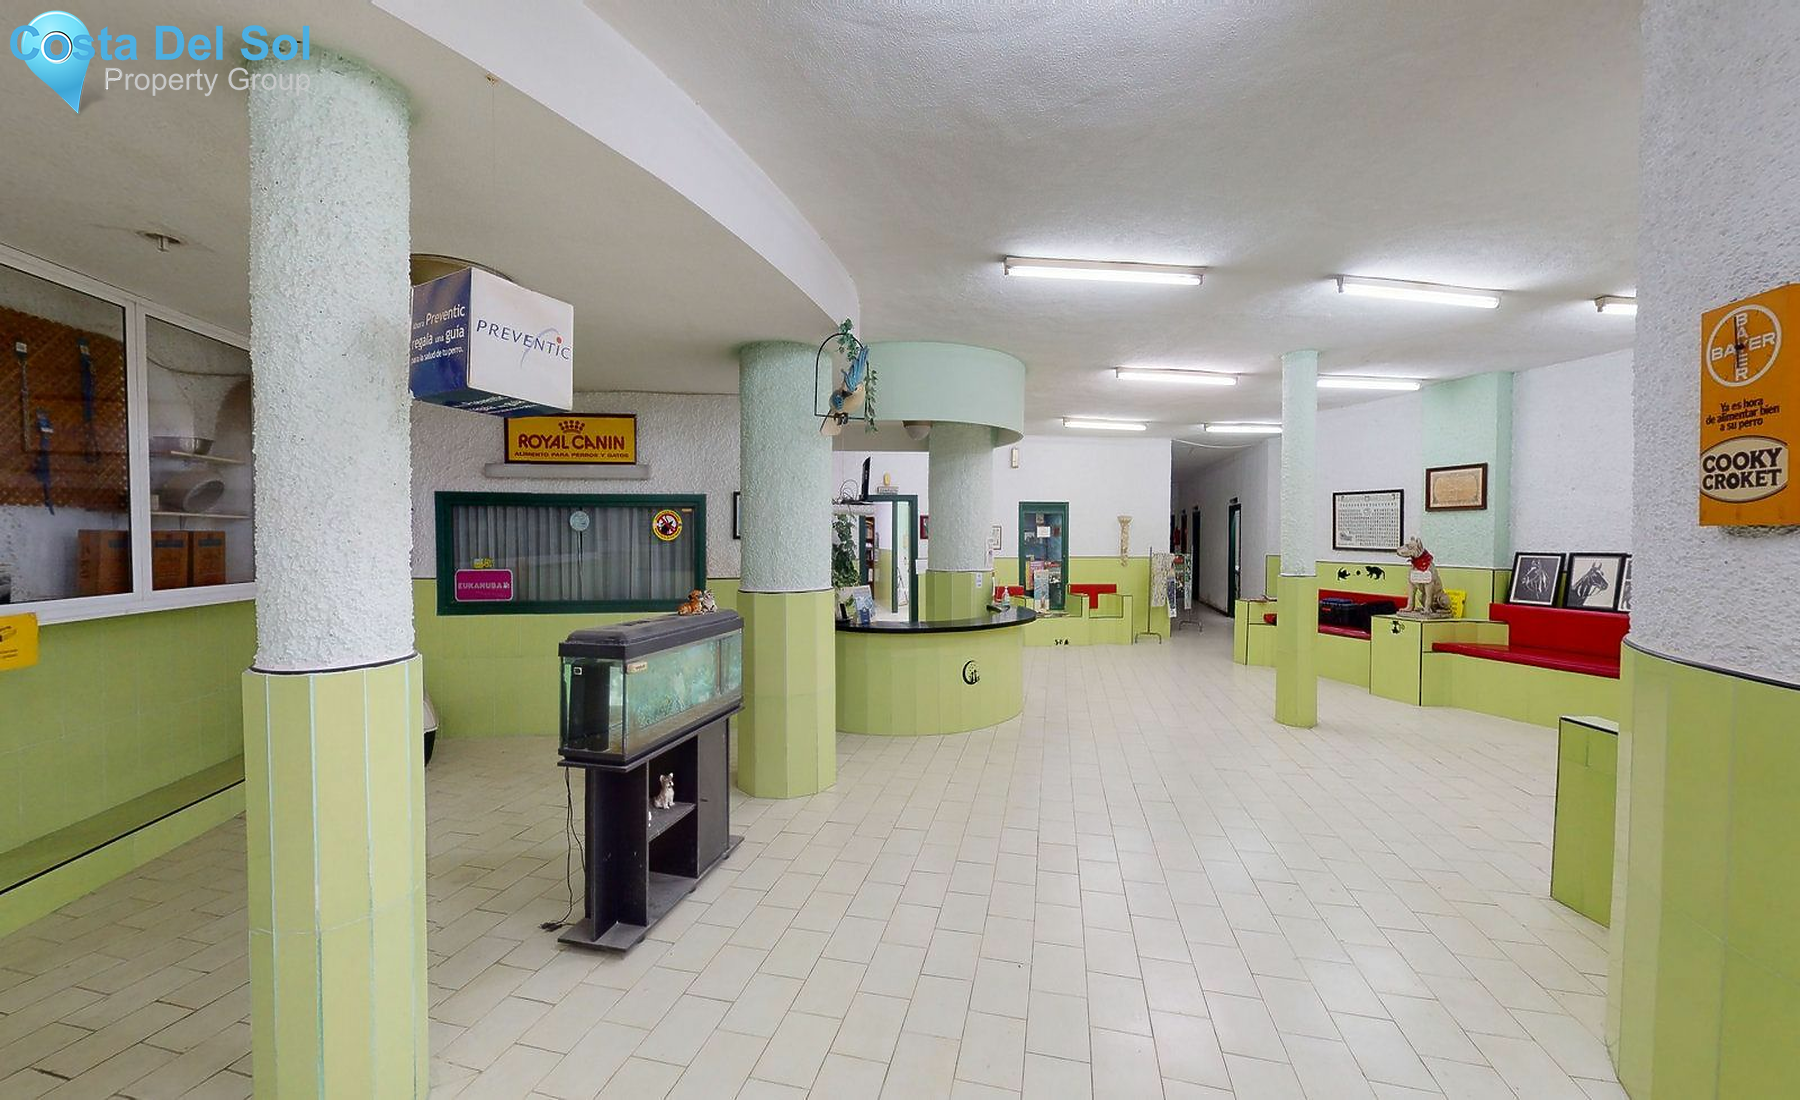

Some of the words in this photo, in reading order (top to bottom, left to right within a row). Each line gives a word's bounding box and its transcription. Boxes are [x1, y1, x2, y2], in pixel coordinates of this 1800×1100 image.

[425, 303, 466, 326] Preventic
[476, 319, 571, 360] PREVENTIC
[1705, 414, 1716, 425] de
[1717, 408, 1758, 423] alimentar
[1760, 404, 1780, 416] bien
[1731, 401, 1742, 410] es
[1743, 398, 1764, 409] hora
[1720, 423, 1726, 431] a
[1727, 421, 1737, 430] su
[1738, 418, 1763, 430] perro
[518, 433, 569, 450] ROYAL
[572, 434, 625, 450] CANIN
[1702, 447, 1783, 473] COOKY
[1702, 468, 1782, 491] CROKET
